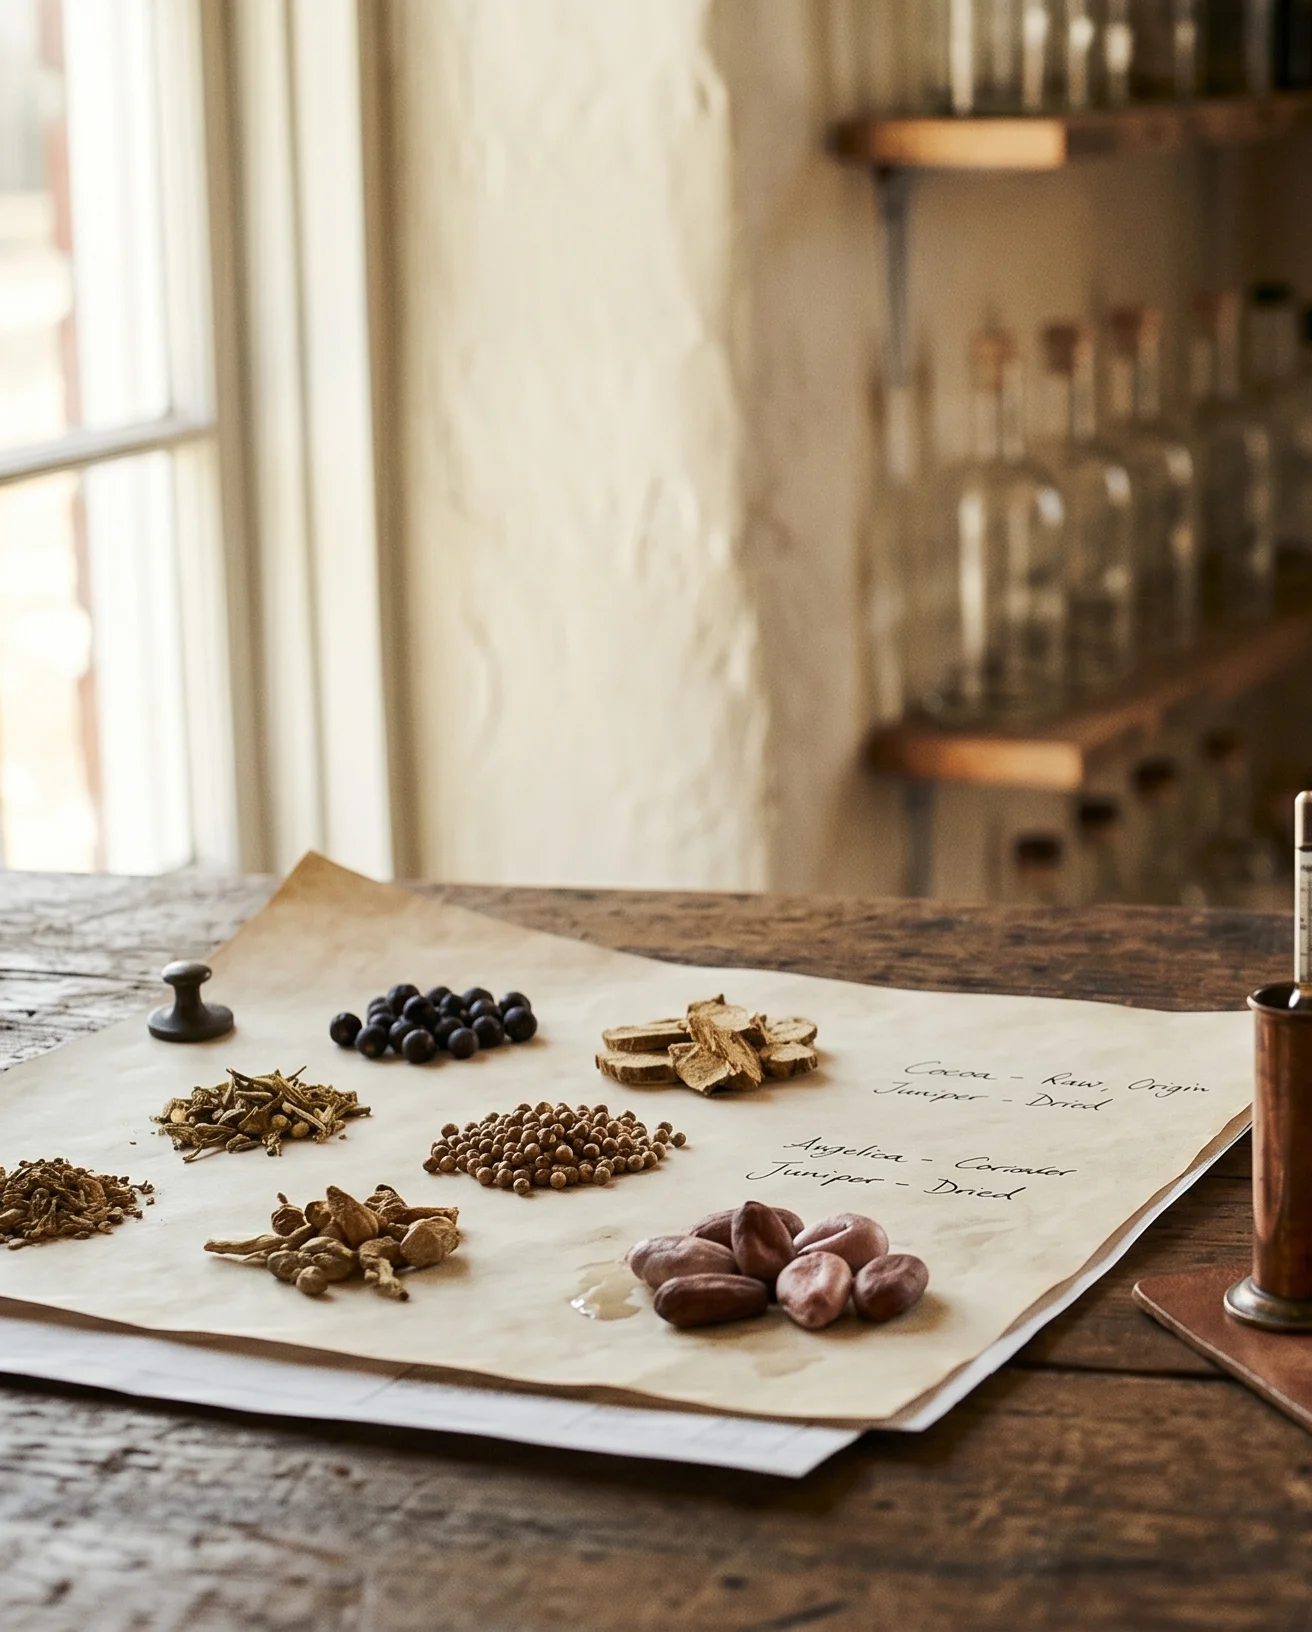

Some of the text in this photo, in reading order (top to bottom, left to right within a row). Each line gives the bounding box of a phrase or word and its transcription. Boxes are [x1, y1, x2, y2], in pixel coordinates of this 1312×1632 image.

[872, 1081, 990, 1103] Juniper
[1024, 1092, 1114, 1112] Dried
[904, 1060, 998, 1081] Cocoa
[1127, 1078, 1211, 1099] Origin
[782, 1136, 909, 1163] Angelica
[745, 1160, 885, 1187] Juniper
[922, 1177, 1028, 1201] Dried
